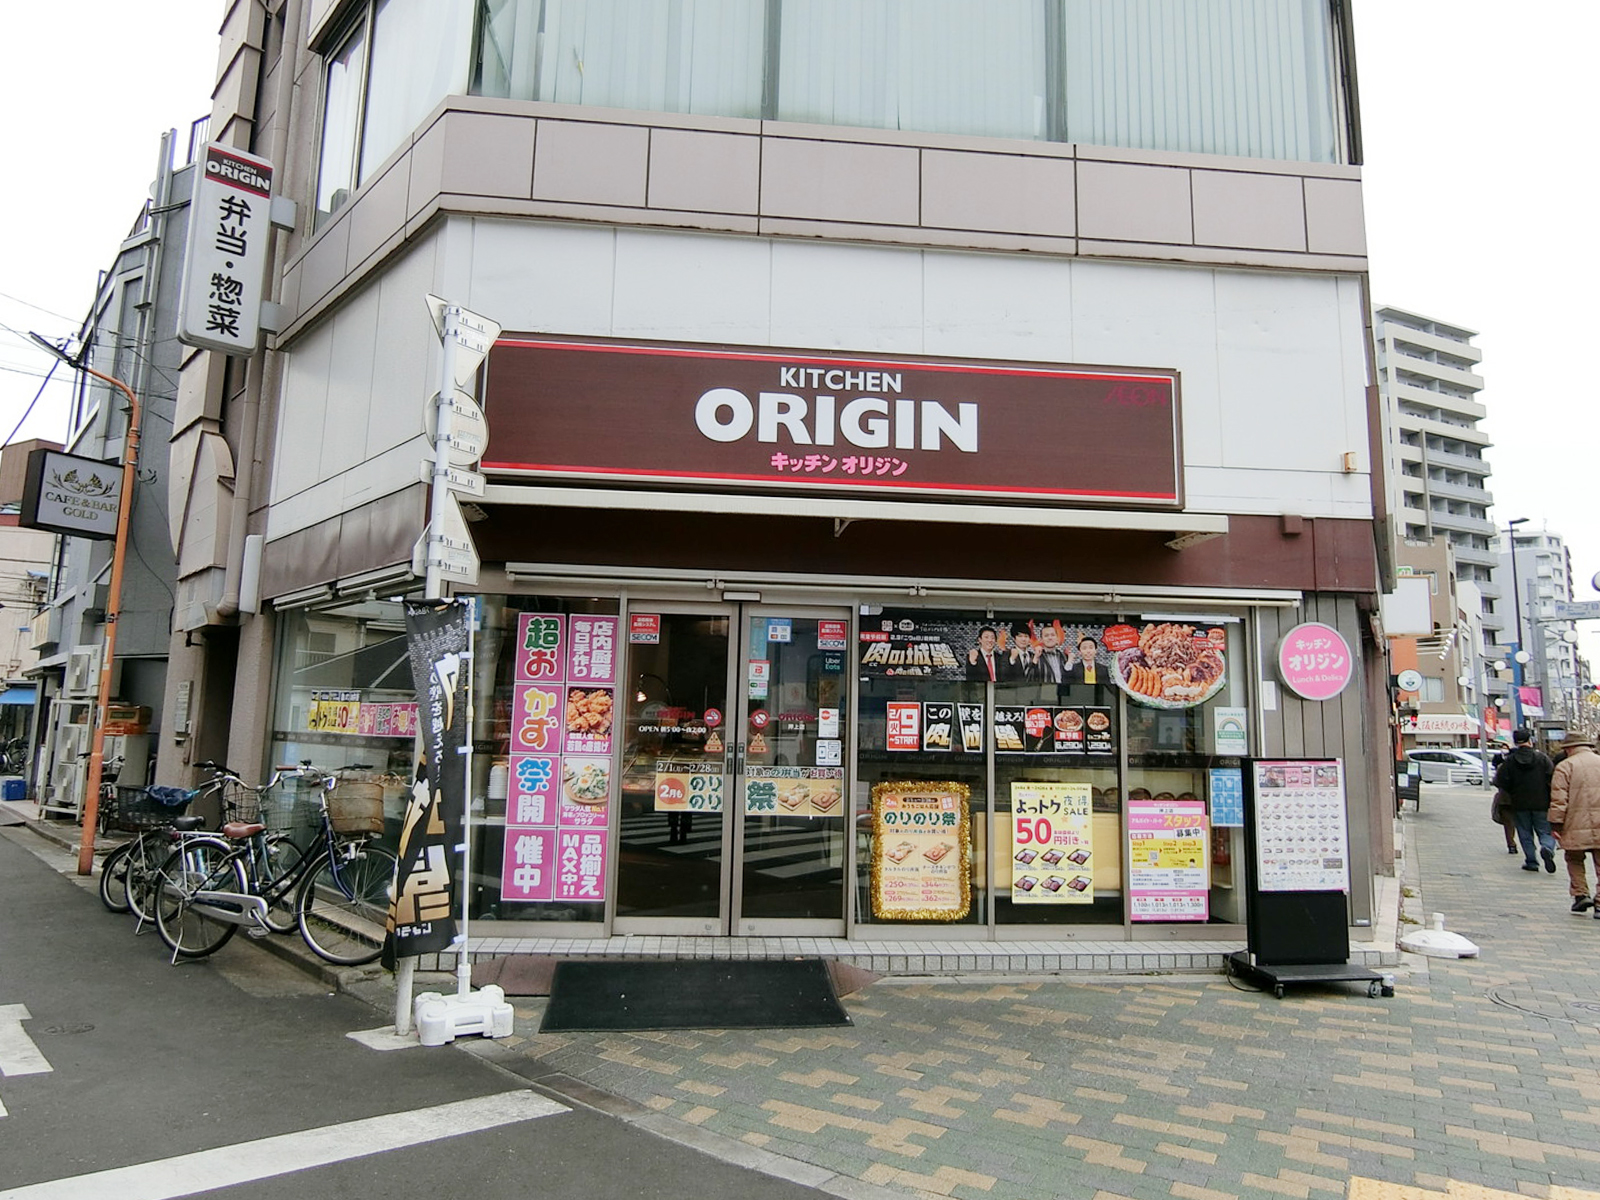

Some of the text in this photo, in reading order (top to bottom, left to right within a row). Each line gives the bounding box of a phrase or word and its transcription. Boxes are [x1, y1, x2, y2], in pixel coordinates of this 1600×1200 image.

[222, 158, 257, 175] KITCHEN
[206, 160, 270, 191] ORIGIN
[205, 195, 252, 338] 弁当・惣菜
[779, 366, 903, 393] KITCHEN
[693, 387, 979, 454] ORIGIN
[770, 452, 909, 477] キッチン オリジン
[45, 491, 118, 513] CAFE & BAR
[62, 506, 99, 521] GOLD
[631, 633, 658, 641] SECOM
[1295, 638, 1332, 650] キッチン
[572, 621, 592, 677] 毎日手作り
[589, 621, 614, 679] 店内厨房
[1288, 653, 1344, 671] オリジン
[1292, 675, 1314, 683] Lunch
[927, 707, 952, 719] この
[690, 776, 722, 792] のり
[689, 793, 722, 810] のり
[747, 780, 777, 811] 祭
[1016, 795, 1089, 815] よっトク 夜得
[1063, 807, 1089, 816] SALE
[884, 811, 956, 826] のりのり祭
[1163, 815, 1202, 827] スタッフ
[1016, 817, 1052, 845] 50
[1176, 828, 1201, 838] 募集中
[1053, 836, 1080, 846] 円引き
[578, 834, 603, 896] 品揃え
